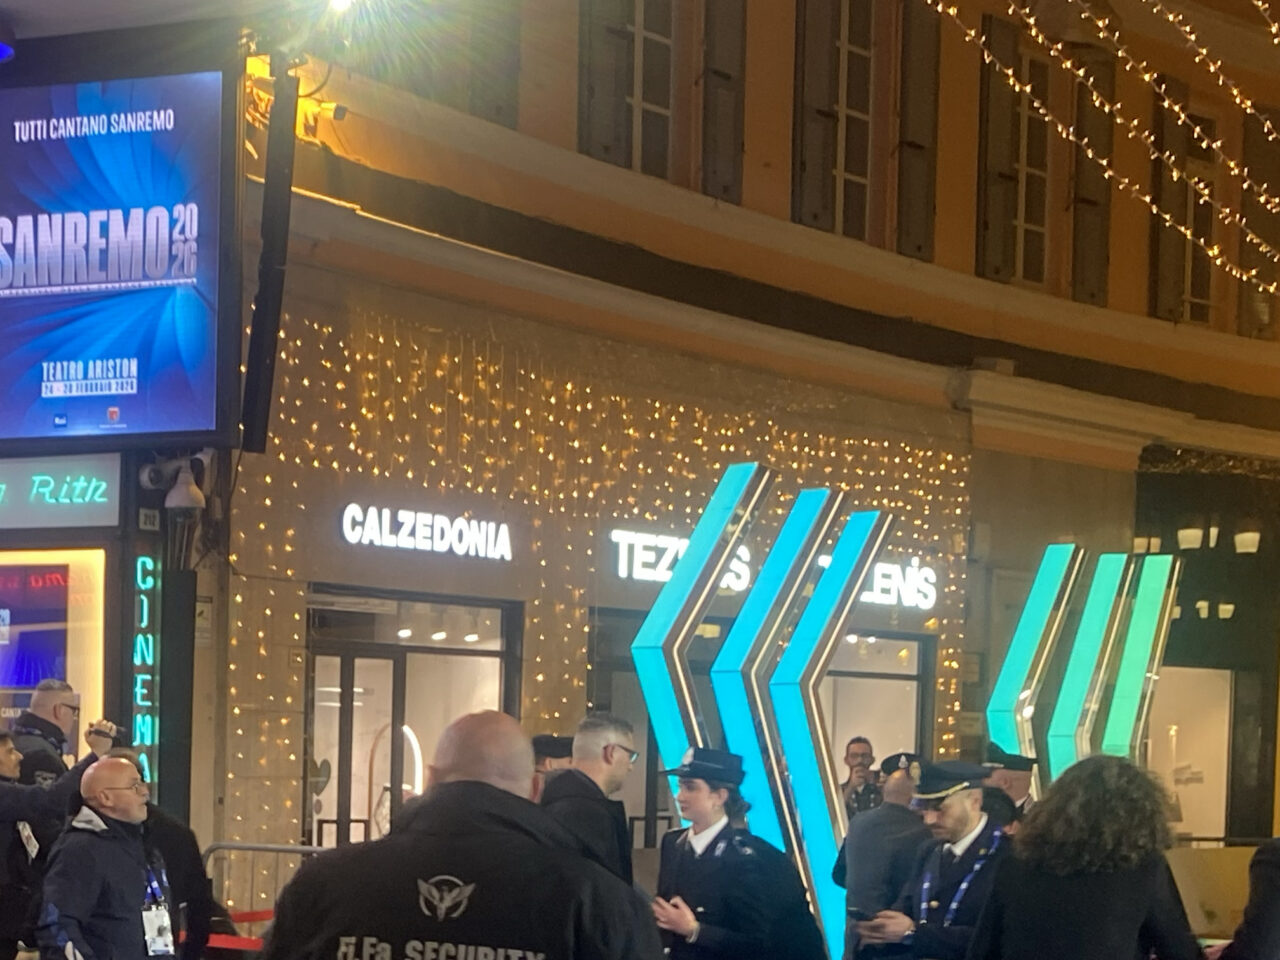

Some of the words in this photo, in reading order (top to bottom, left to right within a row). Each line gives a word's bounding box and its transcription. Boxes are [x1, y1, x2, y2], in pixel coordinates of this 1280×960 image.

[14, 119, 47, 143] TUTTI
[49, 114, 108, 140] CANTANO
[110, 109, 175, 134] SANREMO
[42, 361, 84, 381] TEATRO
[87, 358, 138, 379] ARISTON
[30, 474, 110, 504] Ritz
[342, 503, 512, 561] CALZEDONIA
[611, 529, 751, 592] TEZS
